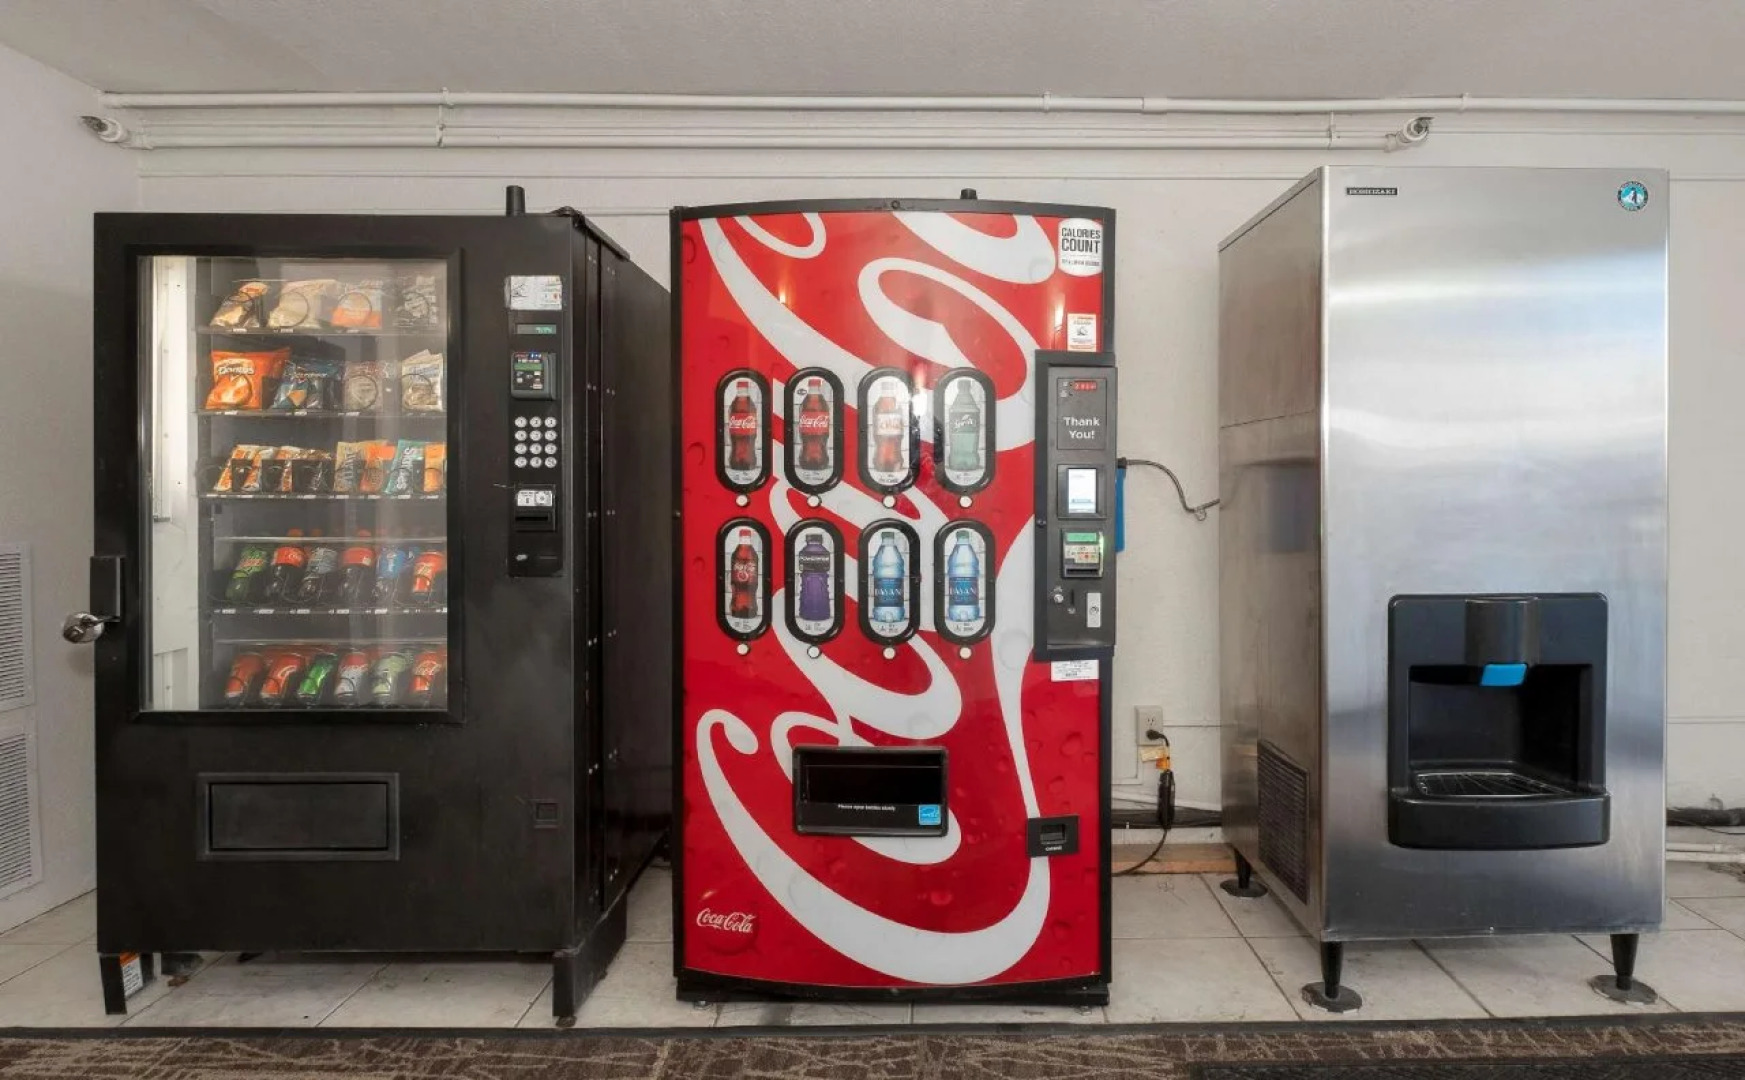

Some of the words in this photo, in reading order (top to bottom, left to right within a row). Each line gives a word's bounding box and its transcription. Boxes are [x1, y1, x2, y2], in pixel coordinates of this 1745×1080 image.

[1061, 227, 1101, 239] CALORIES
[1061, 238, 1101, 254] COUNT
[1063, 416, 1100, 426] Thank
[1069, 430, 1095, 439] You!
[696, 907, 757, 933] Coca-Cola
